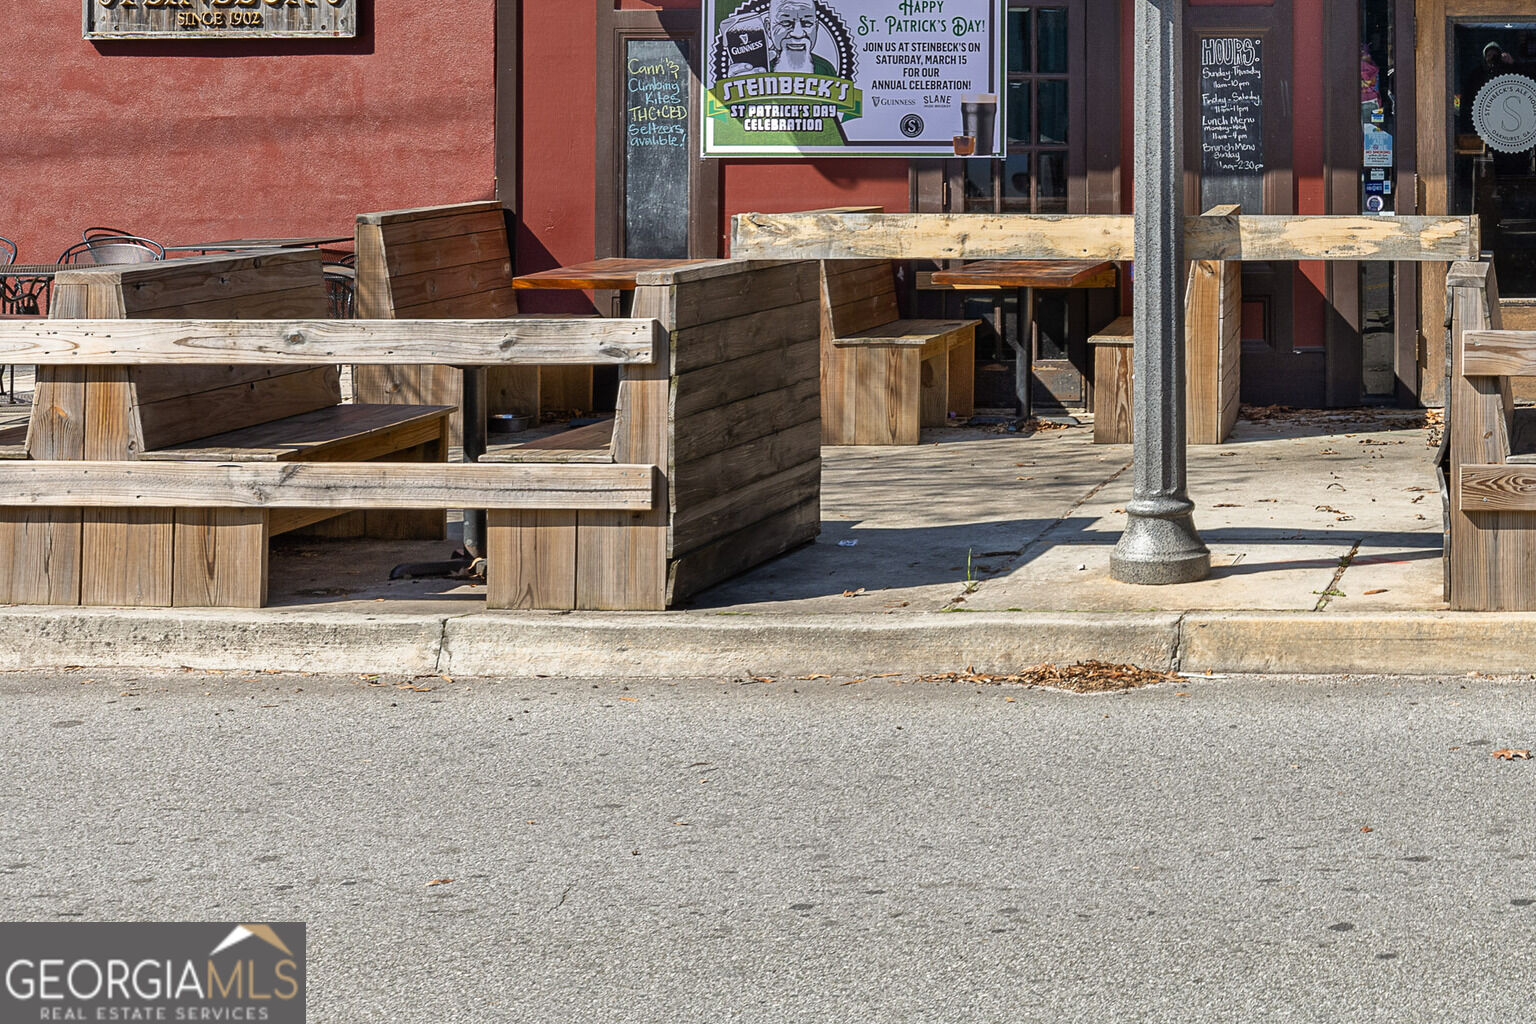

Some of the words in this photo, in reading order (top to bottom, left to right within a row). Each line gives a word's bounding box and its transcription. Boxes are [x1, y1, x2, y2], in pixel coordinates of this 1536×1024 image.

[177, 12, 223, 25] SINCE
[229, 11, 261, 25] 1902
[731, 42, 763, 55] GUINNESS
[863, 43, 883, 52] JOIN
[885, 43, 896, 52] US
[899, 43, 909, 52] AT
[911, 43, 966, 52] STEINBECK'S
[968, 43, 980, 52] ON
[1202, 38, 1260, 66] HOURS:
[628, 58, 665, 74] Cann
[876, 55, 923, 65] SATURDAY,
[925, 56, 956, 64] MARCH
[958, 56, 967, 64] 15
[903, 68, 920, 77] FOR
[922, 68, 939, 77] OUR
[628, 77, 679, 95] Climbing
[723, 76, 849, 100] STEINBECK'S
[872, 80, 907, 89] ANNUAL
[909, 80, 971, 89] CELEBRATION!
[646, 92, 681, 104] Kites
[924, 95, 951, 104] SLANE
[1485, 86, 1513, 116] STEINBECK'S
[1516, 88, 1527, 96] ALE
[731, 105, 745, 117] ST
[748, 105, 809, 117] PATRICK'S
[813, 105, 836, 117] DAY
[1502, 96, 1521, 132] S
[744, 119, 823, 131] CELEBRATION
[1203, 116, 1228, 125] Lunch
[1230, 116, 1255, 126] Menu
[1203, 143, 1234, 151] Brunch
[1235, 143, 1255, 151] Menu
